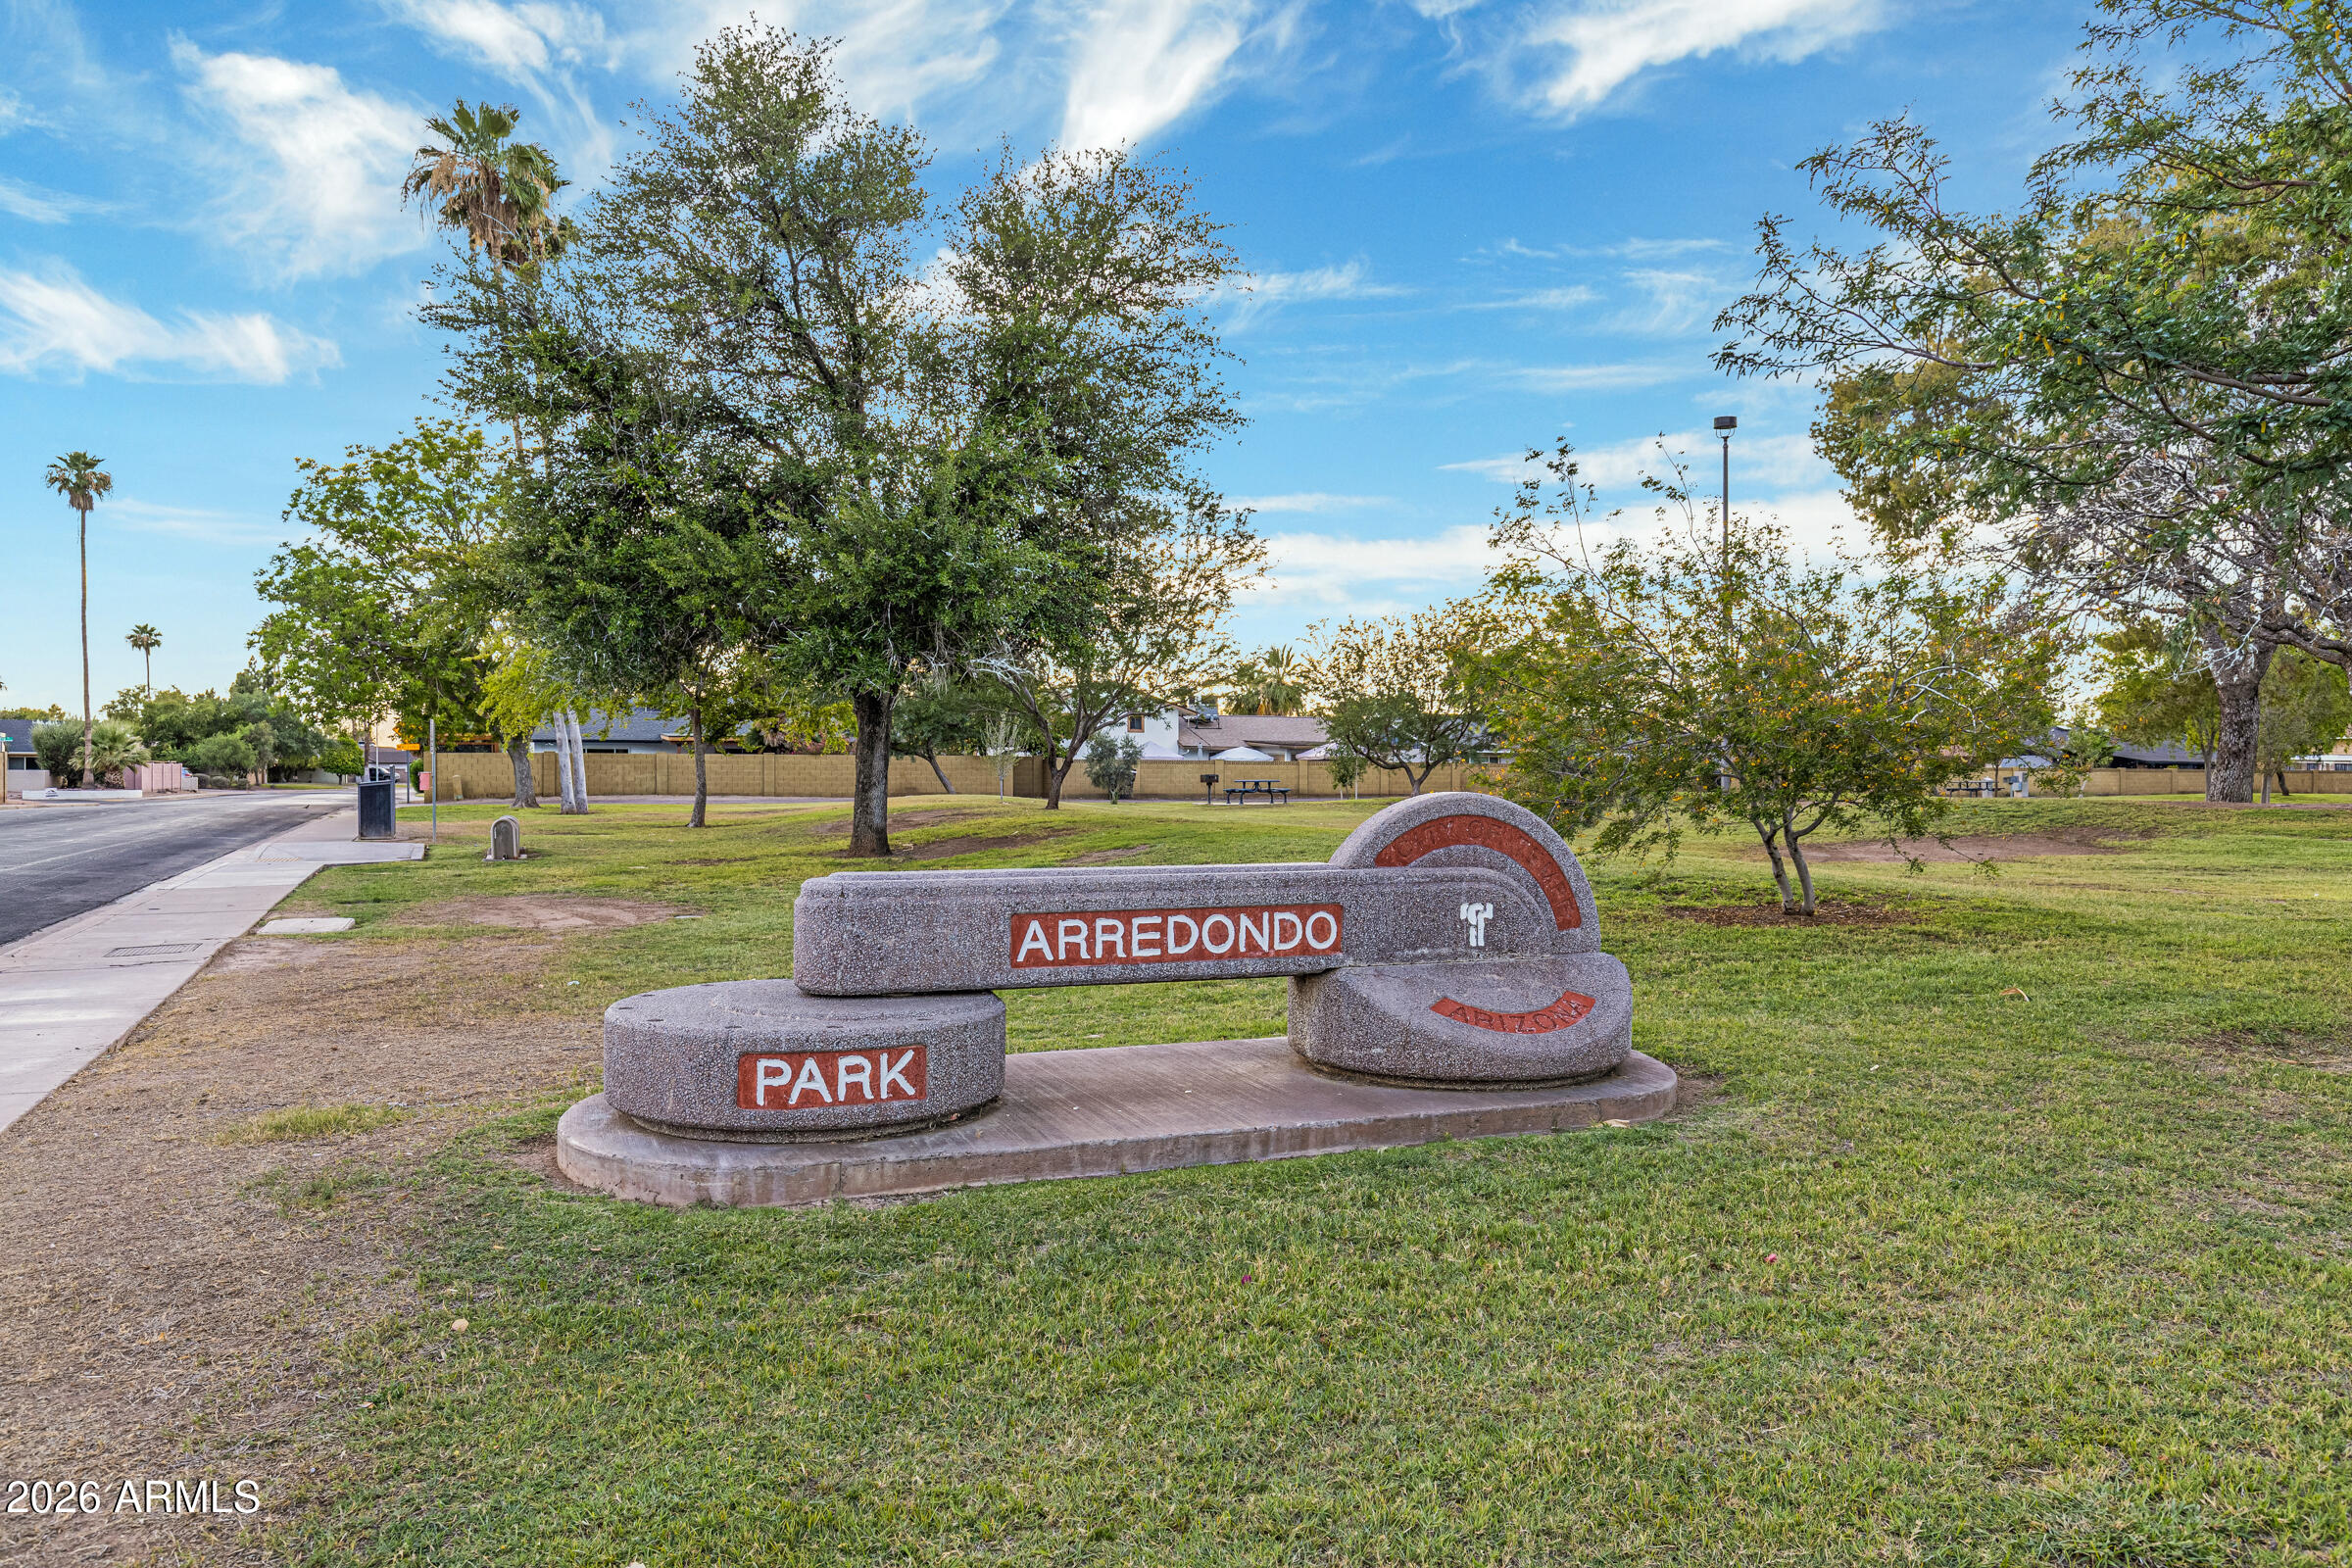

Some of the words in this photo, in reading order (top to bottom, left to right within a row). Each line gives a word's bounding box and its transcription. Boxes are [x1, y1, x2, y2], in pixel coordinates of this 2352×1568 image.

[1016, 911, 1338, 962] ARREDONDO
[1447, 998, 1591, 1034] ARIZONA
[756, 1049, 916, 1106] PARK
